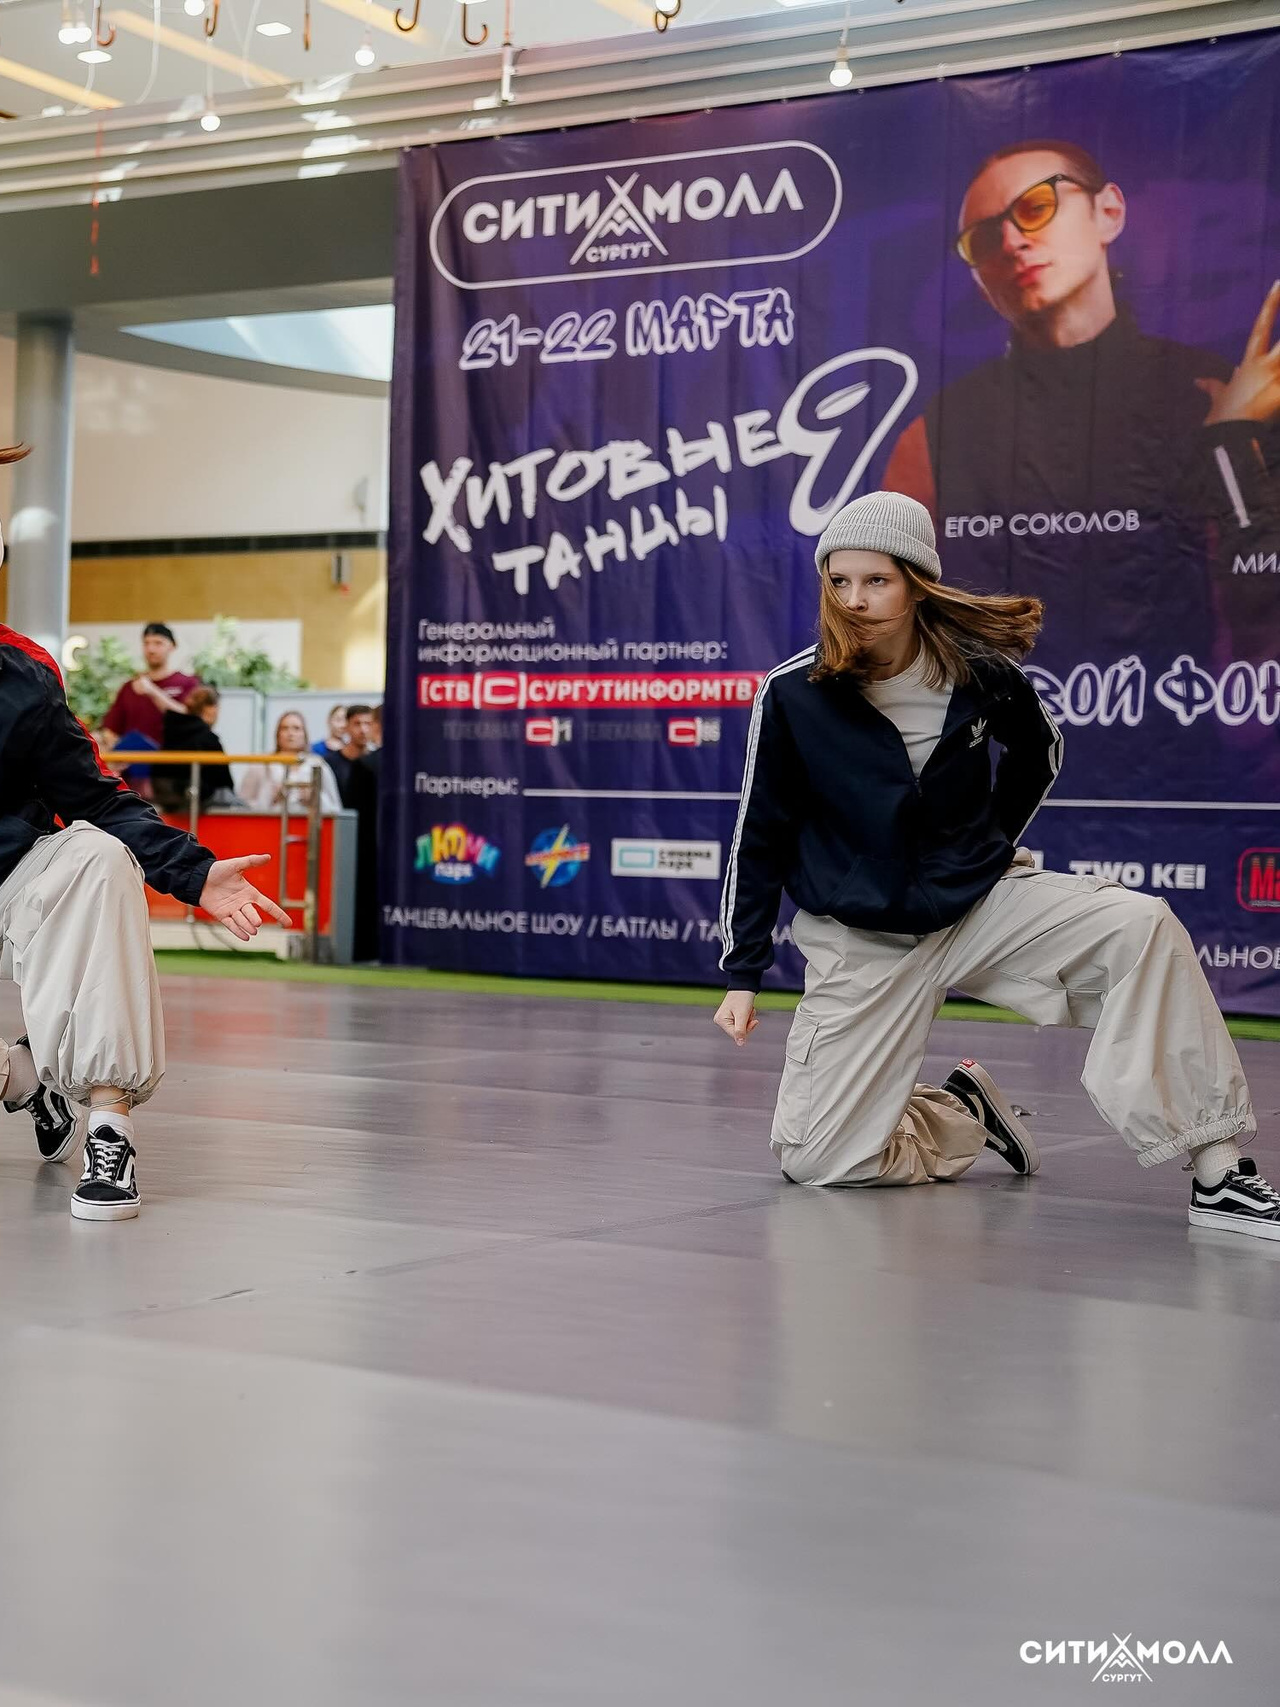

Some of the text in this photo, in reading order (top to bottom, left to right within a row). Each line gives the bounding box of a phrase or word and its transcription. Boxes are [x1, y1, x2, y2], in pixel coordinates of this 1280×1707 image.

[462, 167, 805, 244] СИТИ МОЛЛ
[585, 242, 653, 264] СУРГУТ
[458, 286, 795, 371] 21-22 МАРТА
[419, 409, 784, 553] ХИТОВЫЕ
[944, 509, 1141, 539] ЕГОР СОКОЛОВ
[492, 485, 728, 595] ТАНЦЫ
[1231, 551, 1280, 575] МИ
[418, 616, 557, 641] Генеральный
[417, 637, 729, 667] информационный партнер:
[414, 771, 519, 799] Партнеры:
[1069, 859, 1207, 890] TWO KEI
[382, 904, 529, 934] ТАНЦЕВАЛЬНОЕ
[531, 912, 584, 937] ШОУ
[600, 915, 679, 941] БАТТЛЫ
